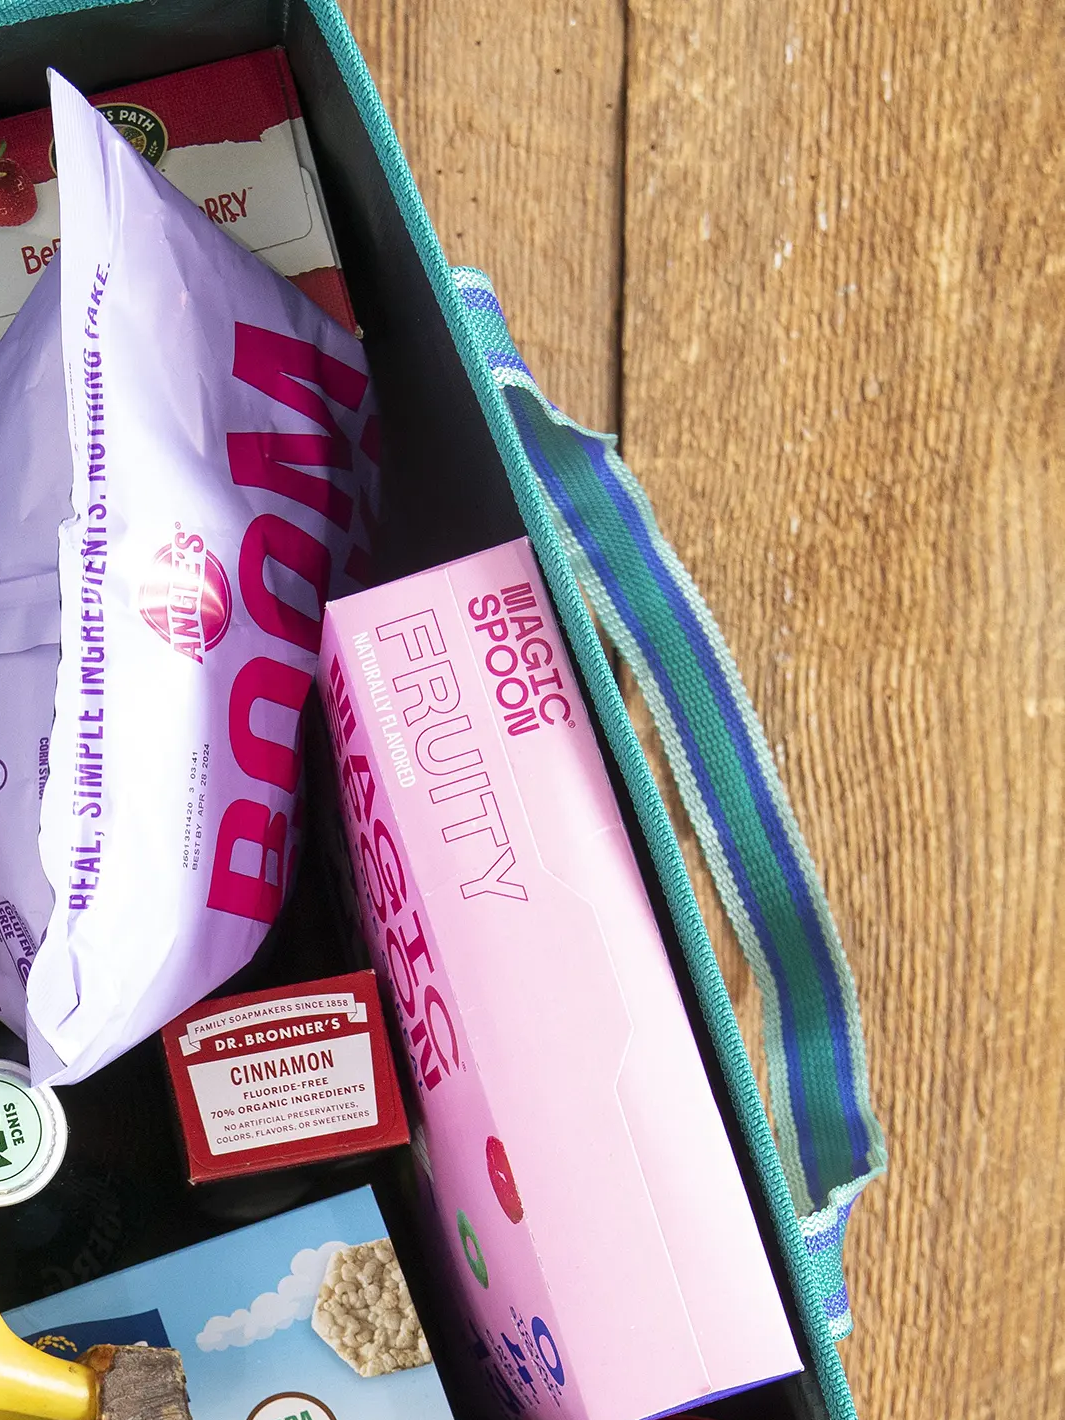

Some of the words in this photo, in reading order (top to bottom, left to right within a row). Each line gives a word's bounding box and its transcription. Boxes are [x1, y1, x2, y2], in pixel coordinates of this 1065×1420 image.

[119, 110, 155, 131] PATH
[207, 321, 368, 924] BOOM
[467, 594, 540, 737] SPOON
[500, 582, 571, 725] MAGIC
[352, 631, 394, 713] NATURALLY
[379, 711, 416, 788] FLAVORED
[376, 609, 528, 901] FRUITY
[197, 793, 206, 817] APR
[202, 744, 210, 769] 2024
[4, 905, 34, 957] GLUTEN
[194, 1018, 226, 1035] FAMILY
[229, 1005, 293, 1024] SOAPMAKERS
[295, 1000, 324, 1011] SINCE
[326, 999, 348, 1008] 1858
[230, 1049, 334, 1085] CINNAMON
[243, 1077, 329, 1100] FLUORIDE-FREE
[210, 1107, 235, 1120] 70%
[238, 1098, 288, 1115] ORGANIC
[291, 1083, 366, 1105] INGREDIENTS
[224, 1123, 237, 1131] NO
[239, 1115, 285, 1130] ARTIFICIAL
[288, 1101, 359, 1120] PRESERVATIVES,
[3, 1102, 25, 1146] SINCE
[216, 1131, 254, 1144] COLORS,
[255, 1124, 297, 1138] FLAVORS,
[298, 1121, 311, 1129] OR
[313, 1110, 370, 1127] SWEETENERS
